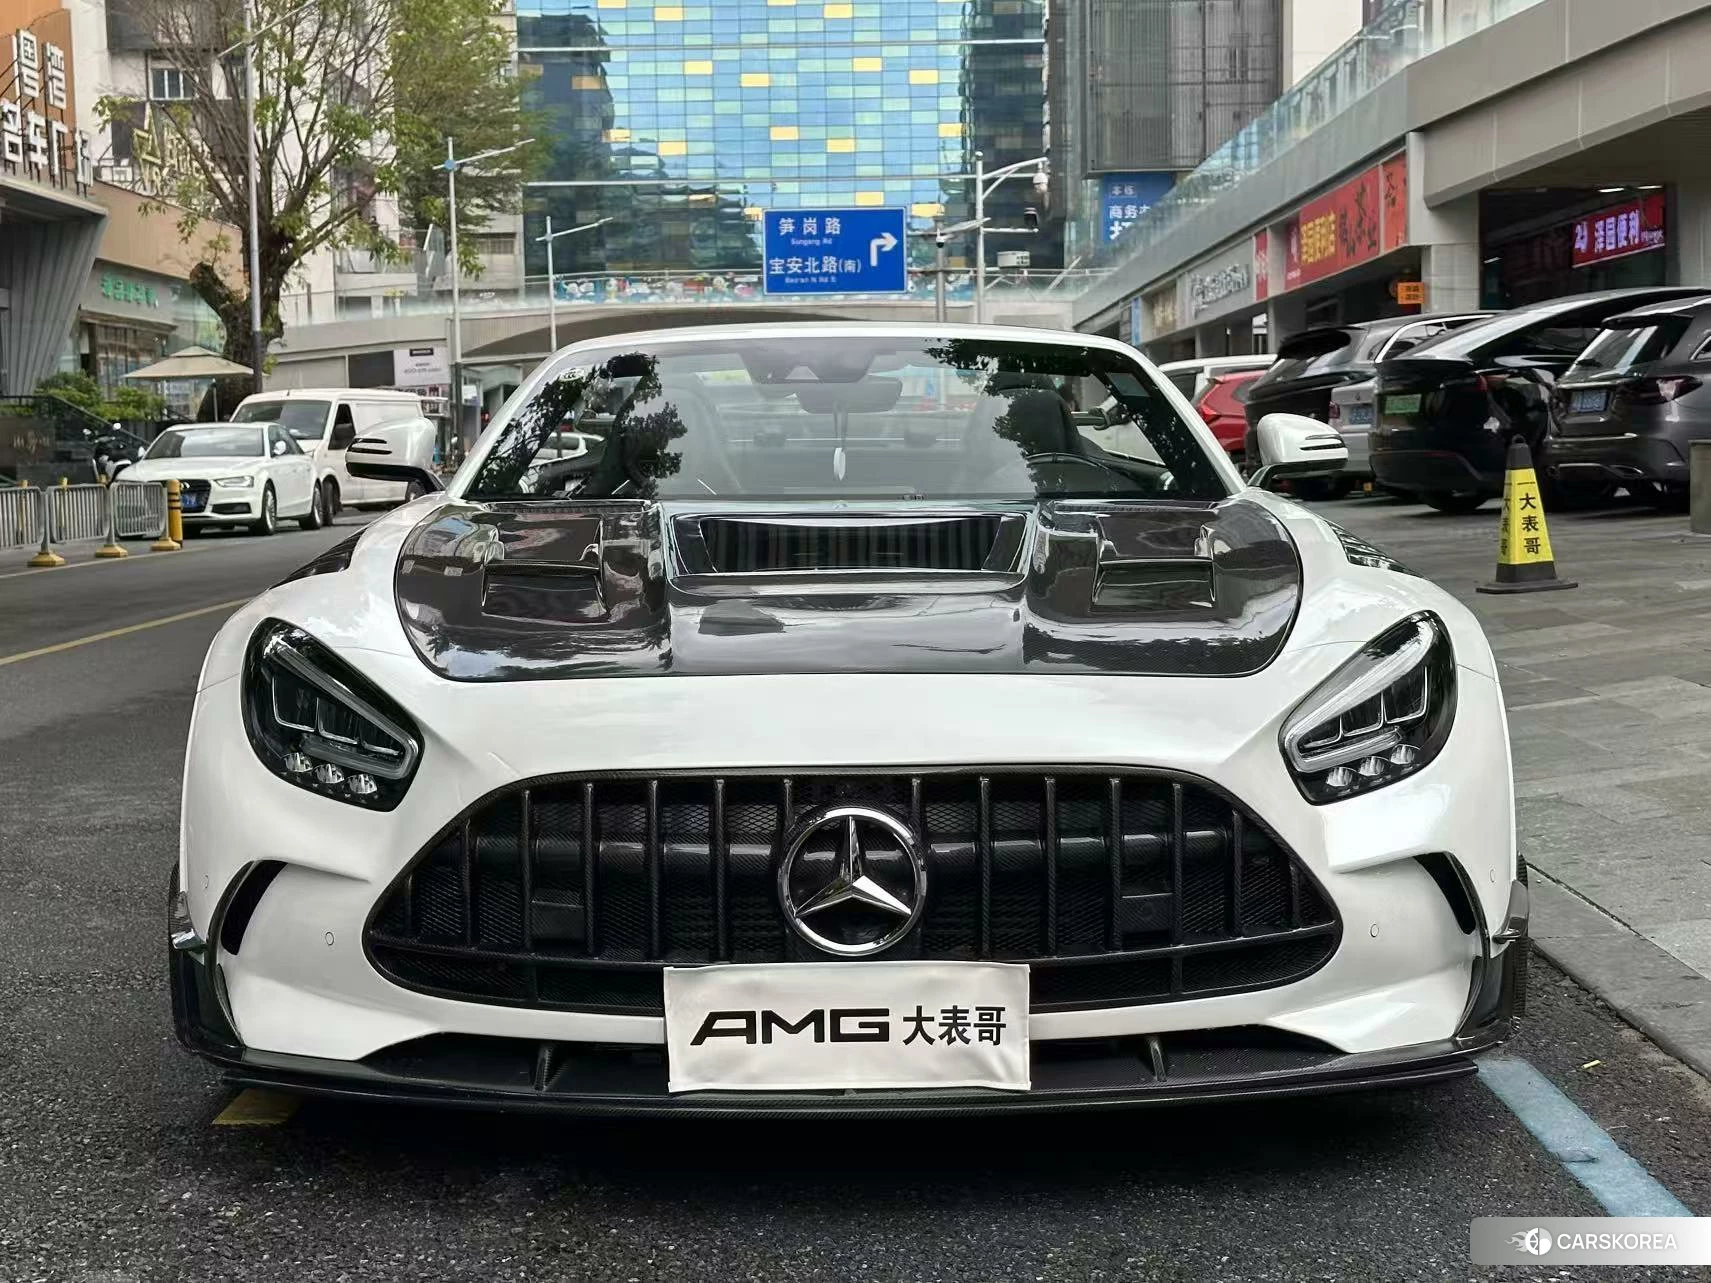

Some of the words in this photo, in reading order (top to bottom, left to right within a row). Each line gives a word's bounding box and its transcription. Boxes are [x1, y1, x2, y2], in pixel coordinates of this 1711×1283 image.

[778, 217, 842, 236] 笋岗路
[791, 238, 820, 246] Sungang
[769, 256, 862, 274] 宝安北路(南)
[1519, 492, 1541, 555] 大表哥
[690, 1008, 890, 1045] AMG
[902, 1005, 1007, 1046] 大表哥
